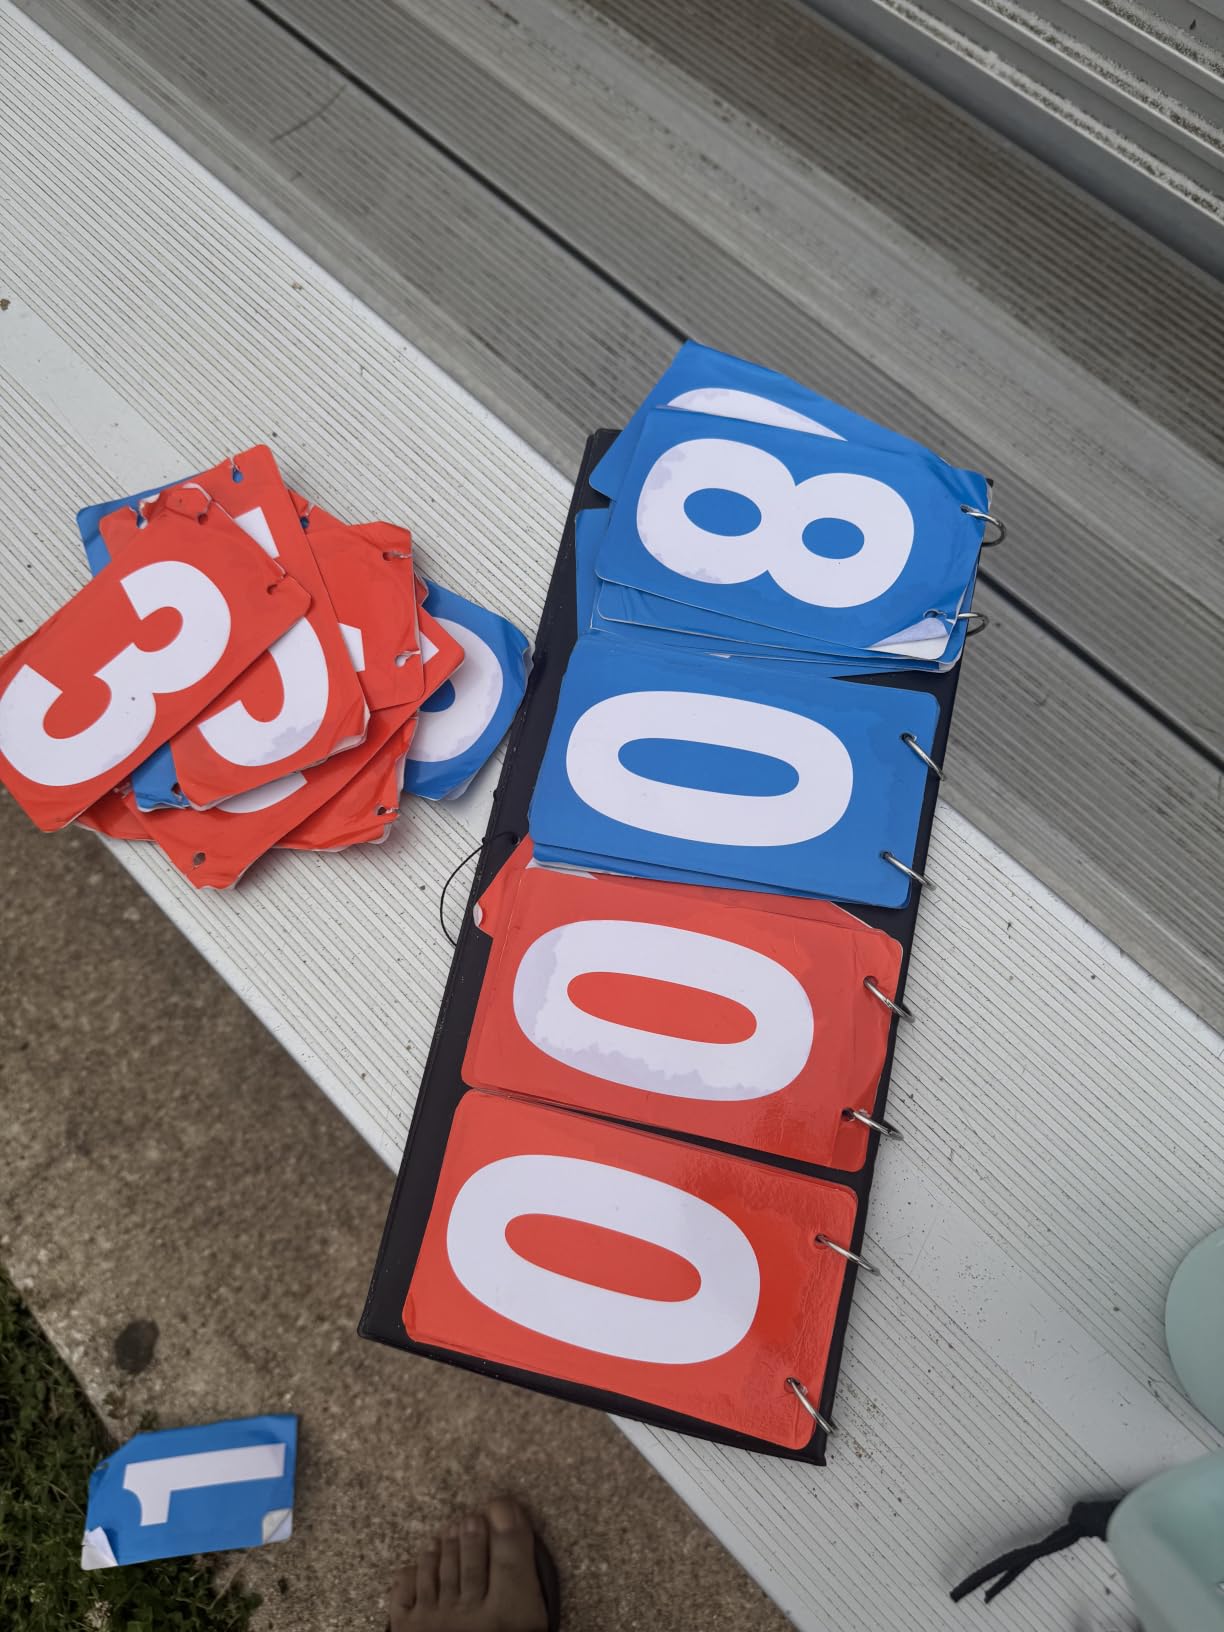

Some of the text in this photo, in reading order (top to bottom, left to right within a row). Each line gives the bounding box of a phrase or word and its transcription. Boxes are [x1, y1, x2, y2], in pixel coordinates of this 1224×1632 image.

[636, 438, 915, 608] 8
[0, 560, 231, 787] 3
[566, 690, 854, 847] 0
[513, 919, 814, 1101] 0
[446, 1154, 761, 1364] 0
[122, 1443, 286, 1527] 1
